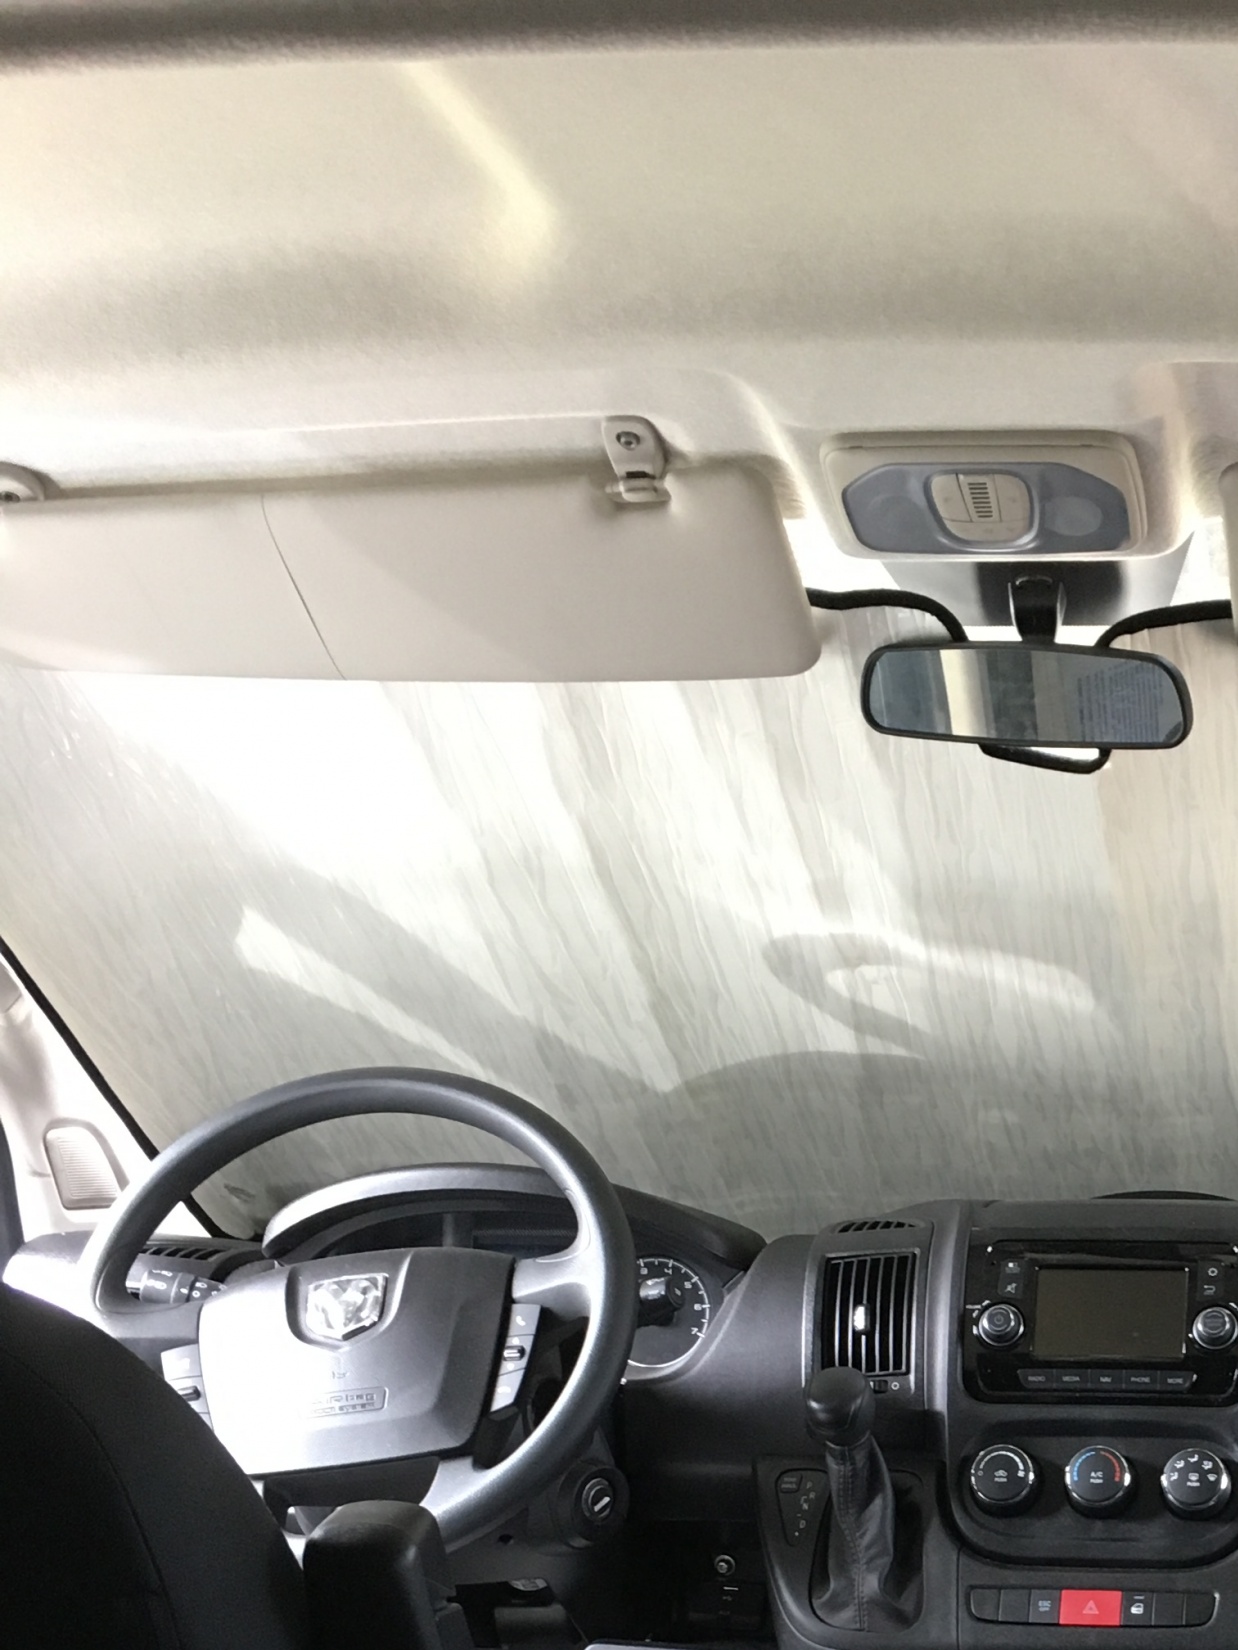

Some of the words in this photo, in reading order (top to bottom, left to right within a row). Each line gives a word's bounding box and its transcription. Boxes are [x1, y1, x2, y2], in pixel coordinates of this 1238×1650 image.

[693, 1303, 702, 1311] 6
[690, 1327, 699, 1335] 7
[806, 1481, 813, 1489] P
[809, 1491, 816, 1499] R
[799, 1519, 806, 1529] D
